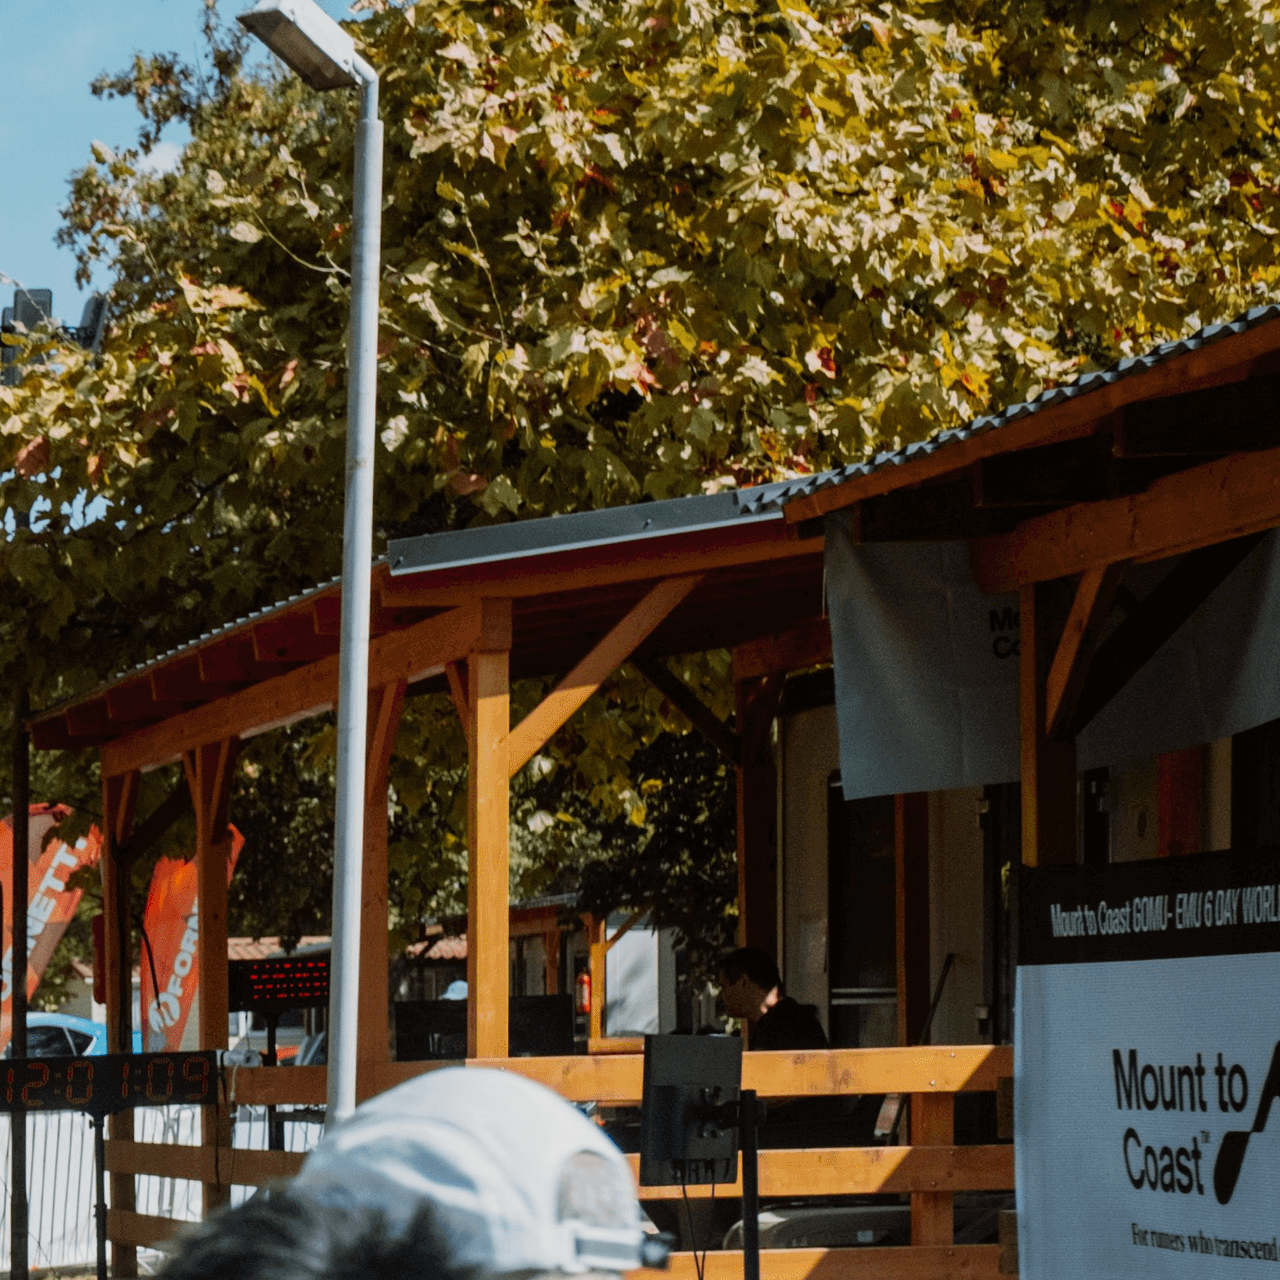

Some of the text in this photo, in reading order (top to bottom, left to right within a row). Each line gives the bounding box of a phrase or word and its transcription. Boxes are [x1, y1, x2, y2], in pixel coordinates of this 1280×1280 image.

[1204, 890, 1213, 927] 6
[1215, 888, 1241, 926] DAY
[1242, 884, 1280, 924] WORL
[1112, 1048, 1248, 1114] Mount to
[1123, 1127, 1204, 1196] Coast
